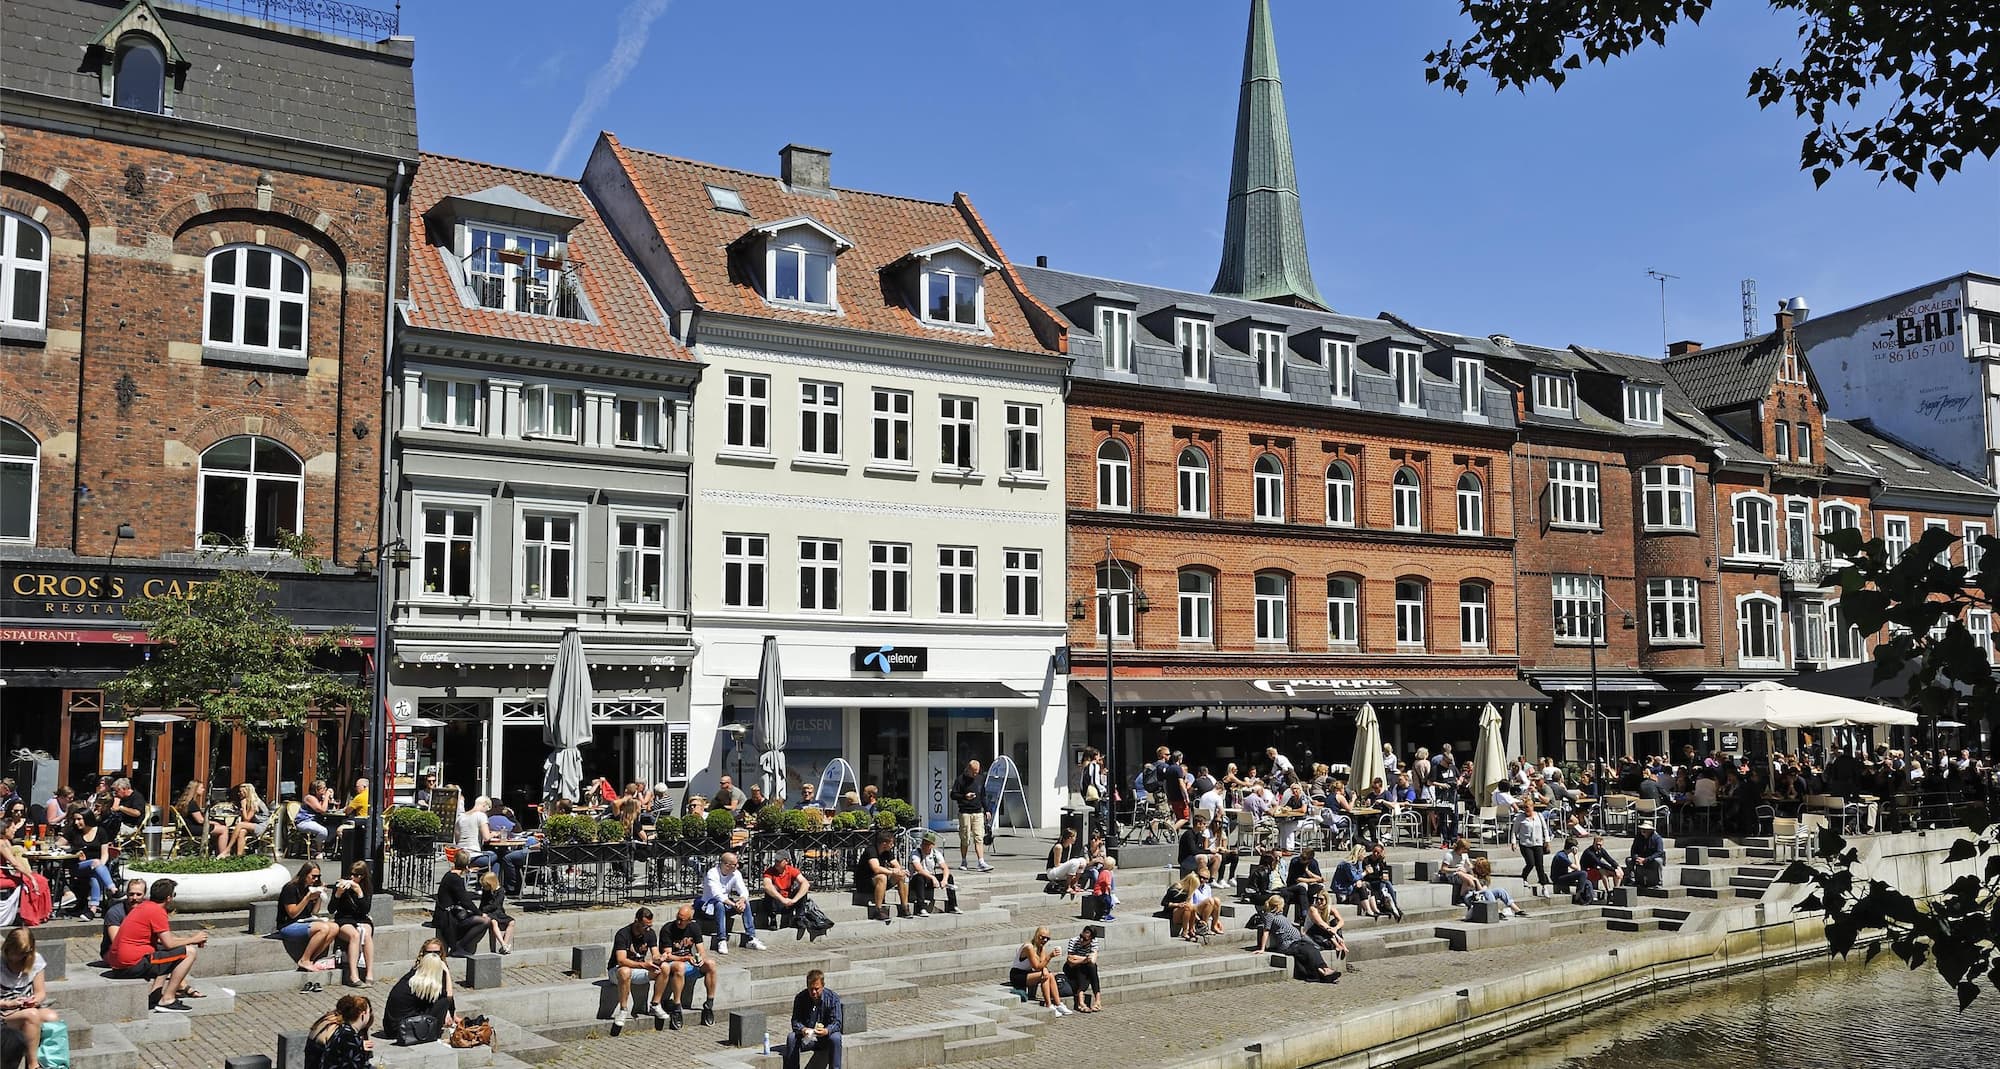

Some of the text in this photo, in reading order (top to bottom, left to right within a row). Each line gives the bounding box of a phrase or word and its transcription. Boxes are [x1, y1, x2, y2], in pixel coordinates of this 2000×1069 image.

[1888, 351, 1903, 364] 86
[1906, 349, 1919, 360] 16
[1922, 344, 1936, 358] 57
[1939, 340, 1954, 354] 00
[12, 573, 124, 599] CROSS
[0, 630, 77, 641] STAURANT
[933, 767, 943, 814] SONY
